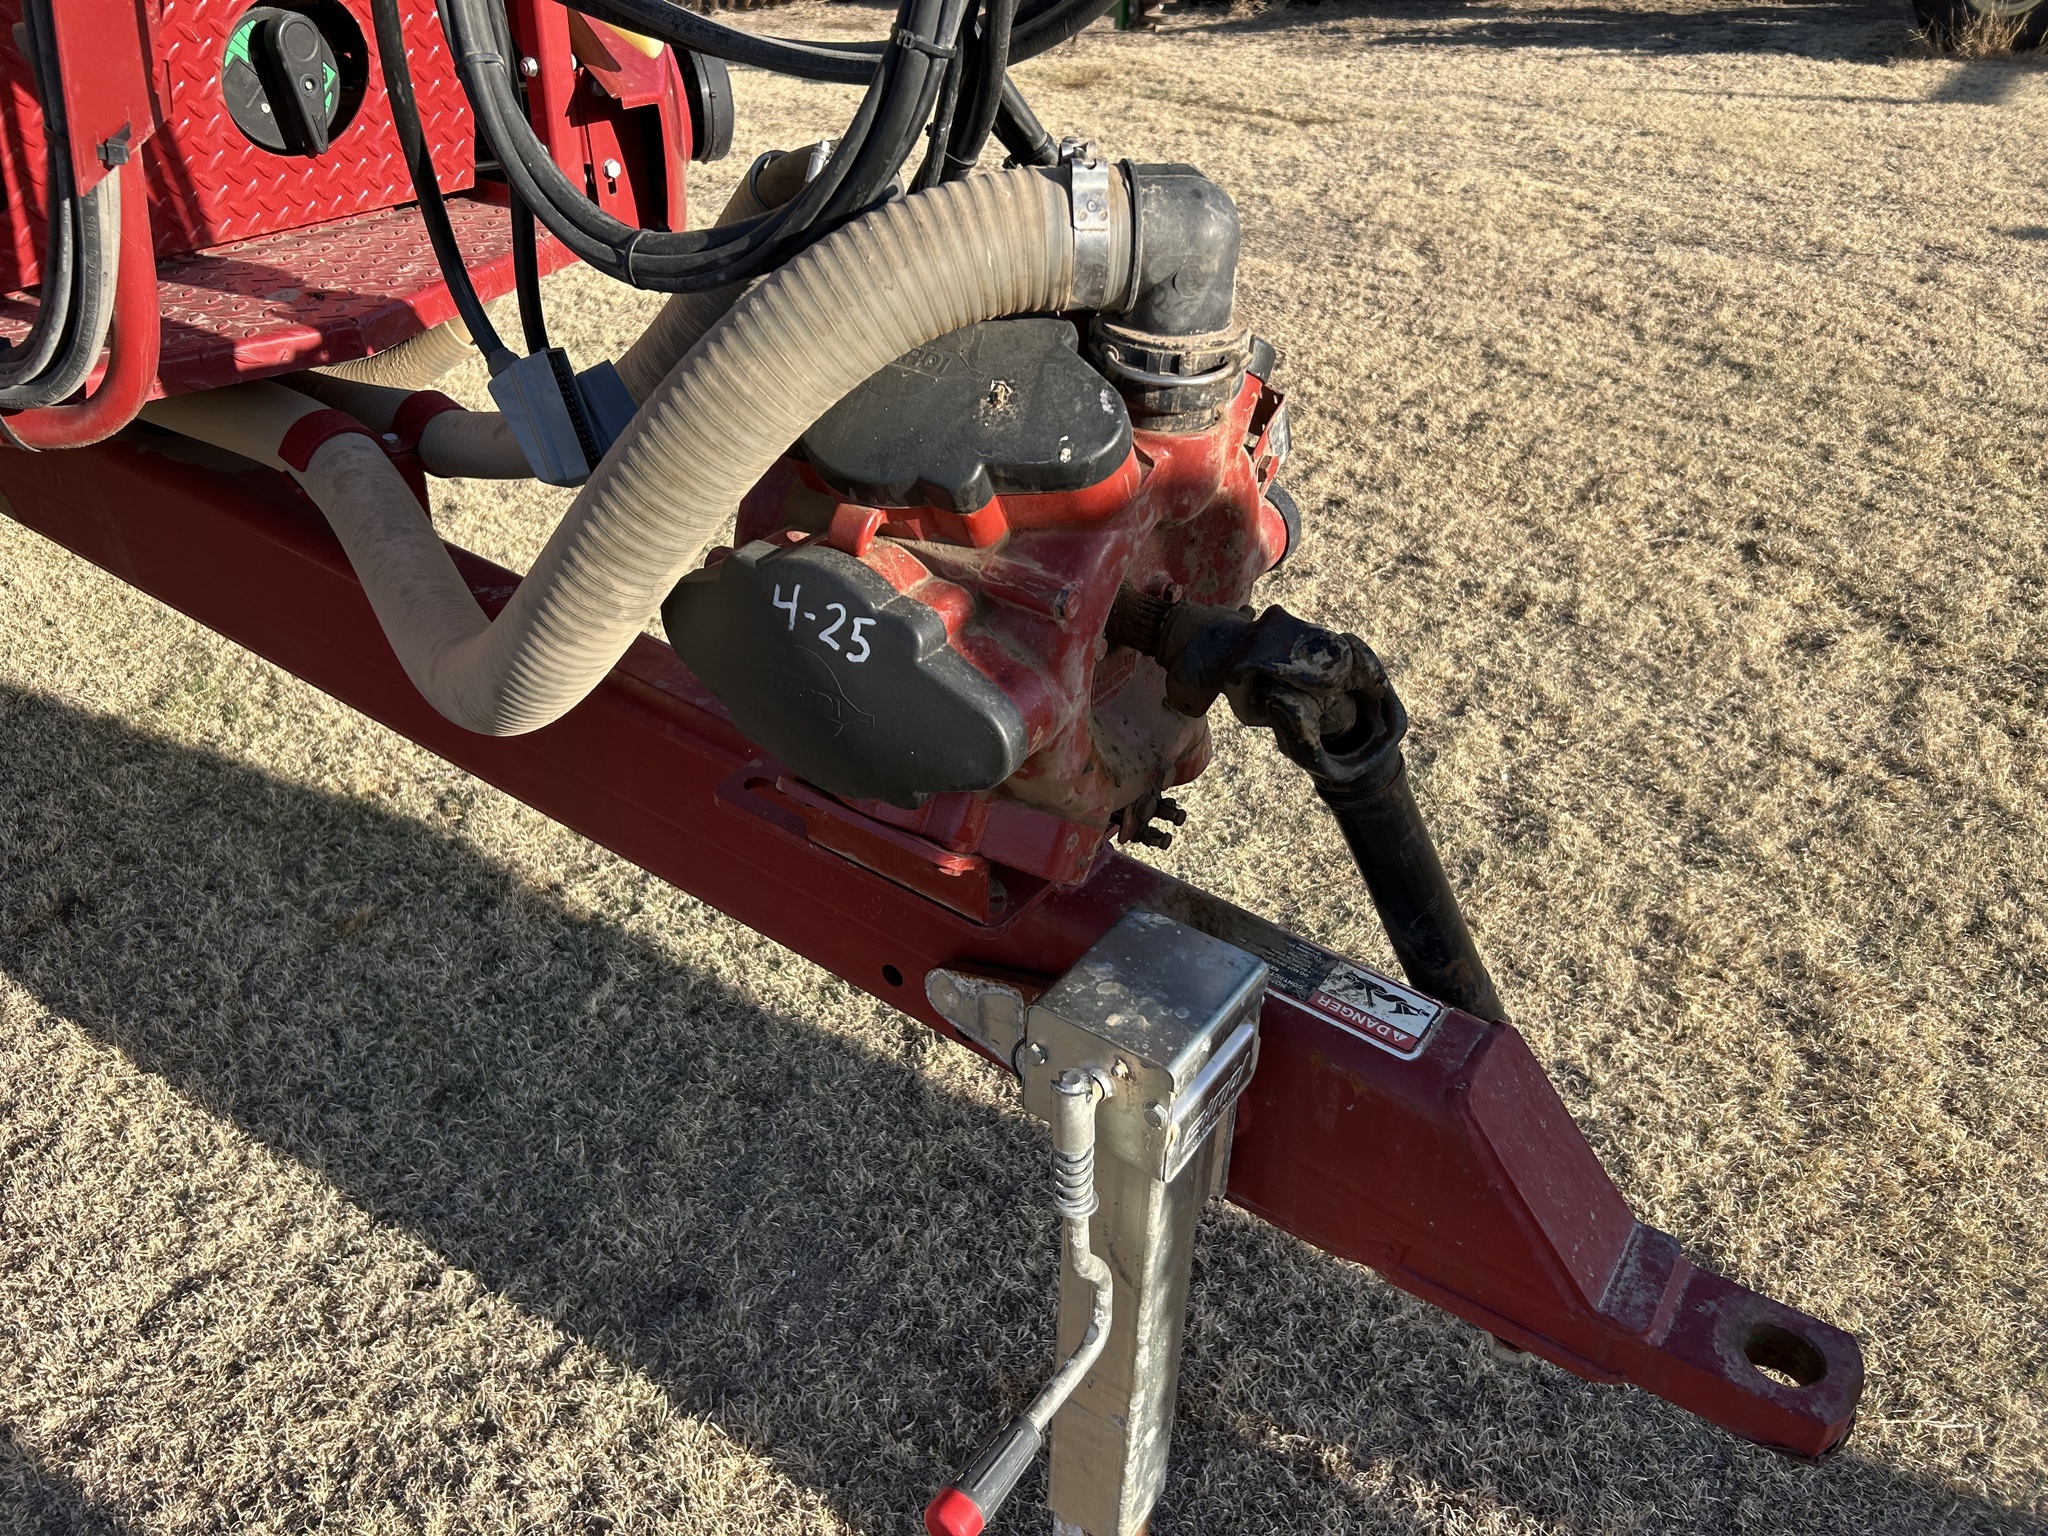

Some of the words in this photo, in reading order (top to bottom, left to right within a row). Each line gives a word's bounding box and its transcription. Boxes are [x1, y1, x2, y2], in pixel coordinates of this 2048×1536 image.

[773, 583, 877, 663] 4-25
[1270, 972, 1304, 990] CONTACT
[1317, 995, 1391, 1036] DANGER
